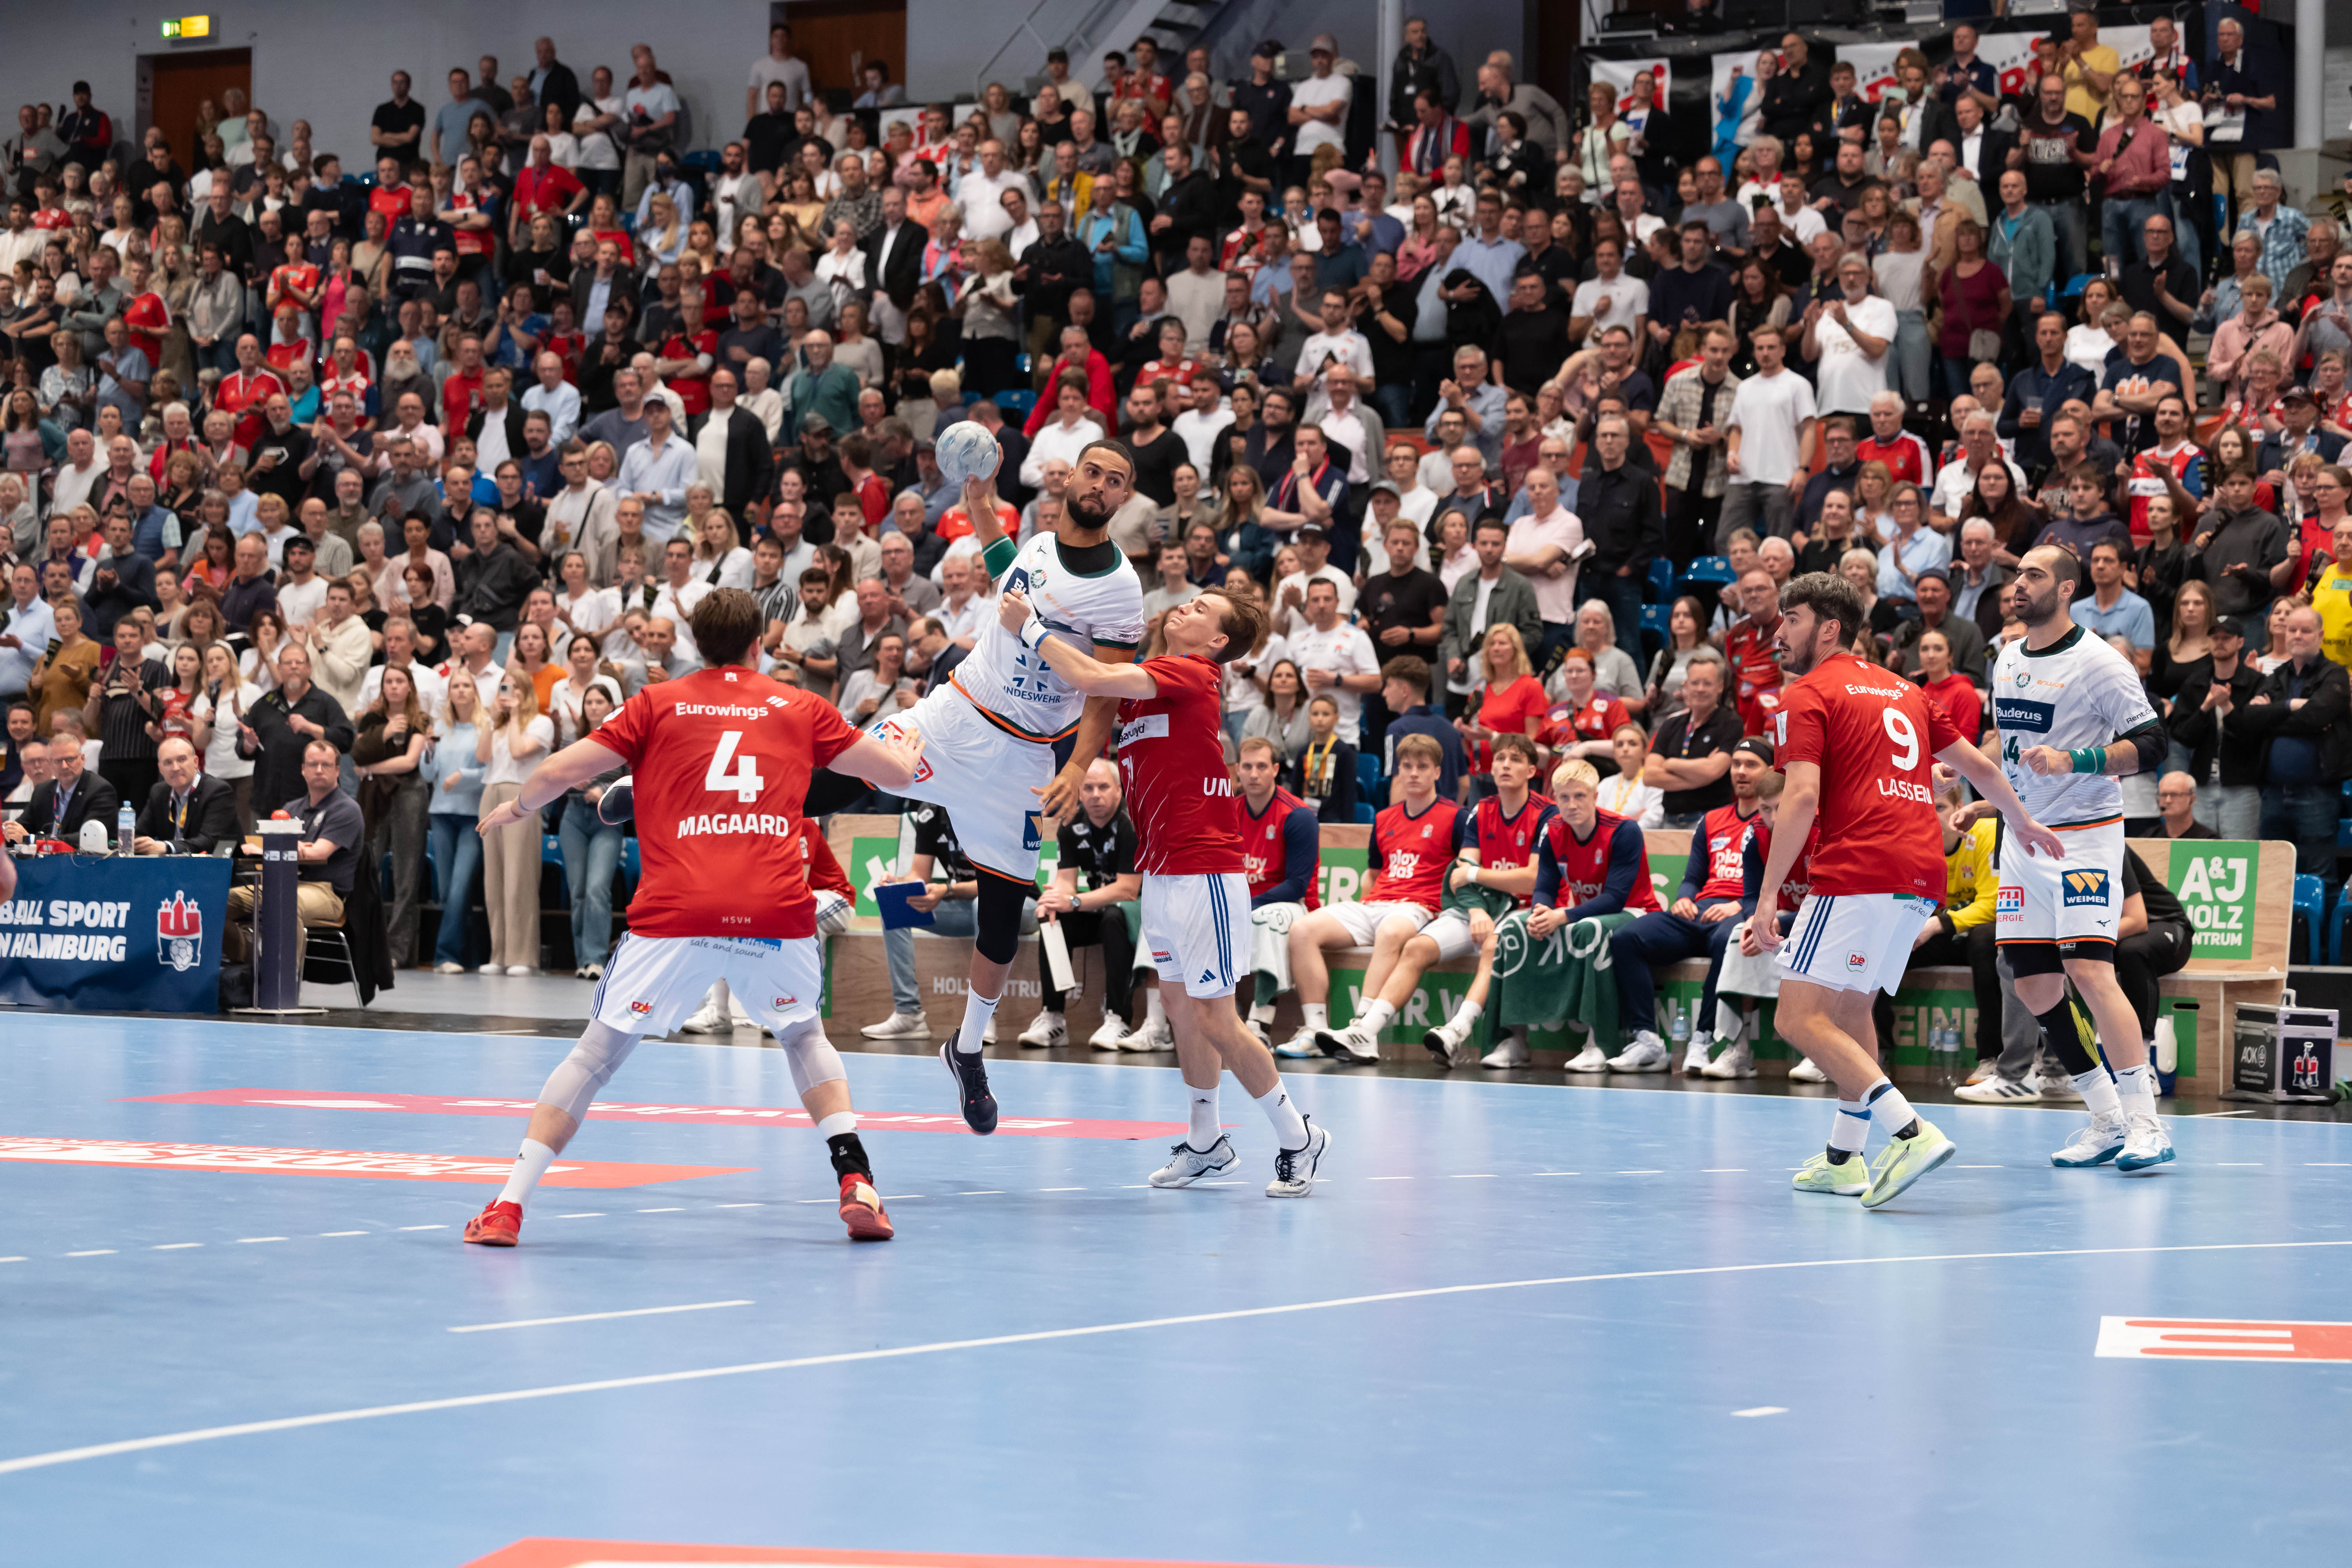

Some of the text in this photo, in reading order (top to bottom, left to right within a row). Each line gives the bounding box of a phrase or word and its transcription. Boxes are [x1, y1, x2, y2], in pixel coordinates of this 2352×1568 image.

[675, 702, 768, 720] Eurowings
[1996, 706, 2042, 721] Buderus
[1882, 707, 1919, 771] 9
[705, 731, 764, 803] 4
[1877, 778, 1933, 804] LASSEN
[677, 813, 789, 840] MAGAARD
[1389, 849, 1420, 867] play
[2177, 856, 2248, 903] A&J
[2066, 895, 2107, 904] WEIMER
[49, 900, 131, 928] SPORT
[722, 916, 751, 925] HSVH
[10, 933, 127, 962] HAMBURG
[690, 937, 766, 958] safe and sound
[2192, 931, 2242, 947] NTRUM
[2240, 1046, 2258, 1064] AOK
